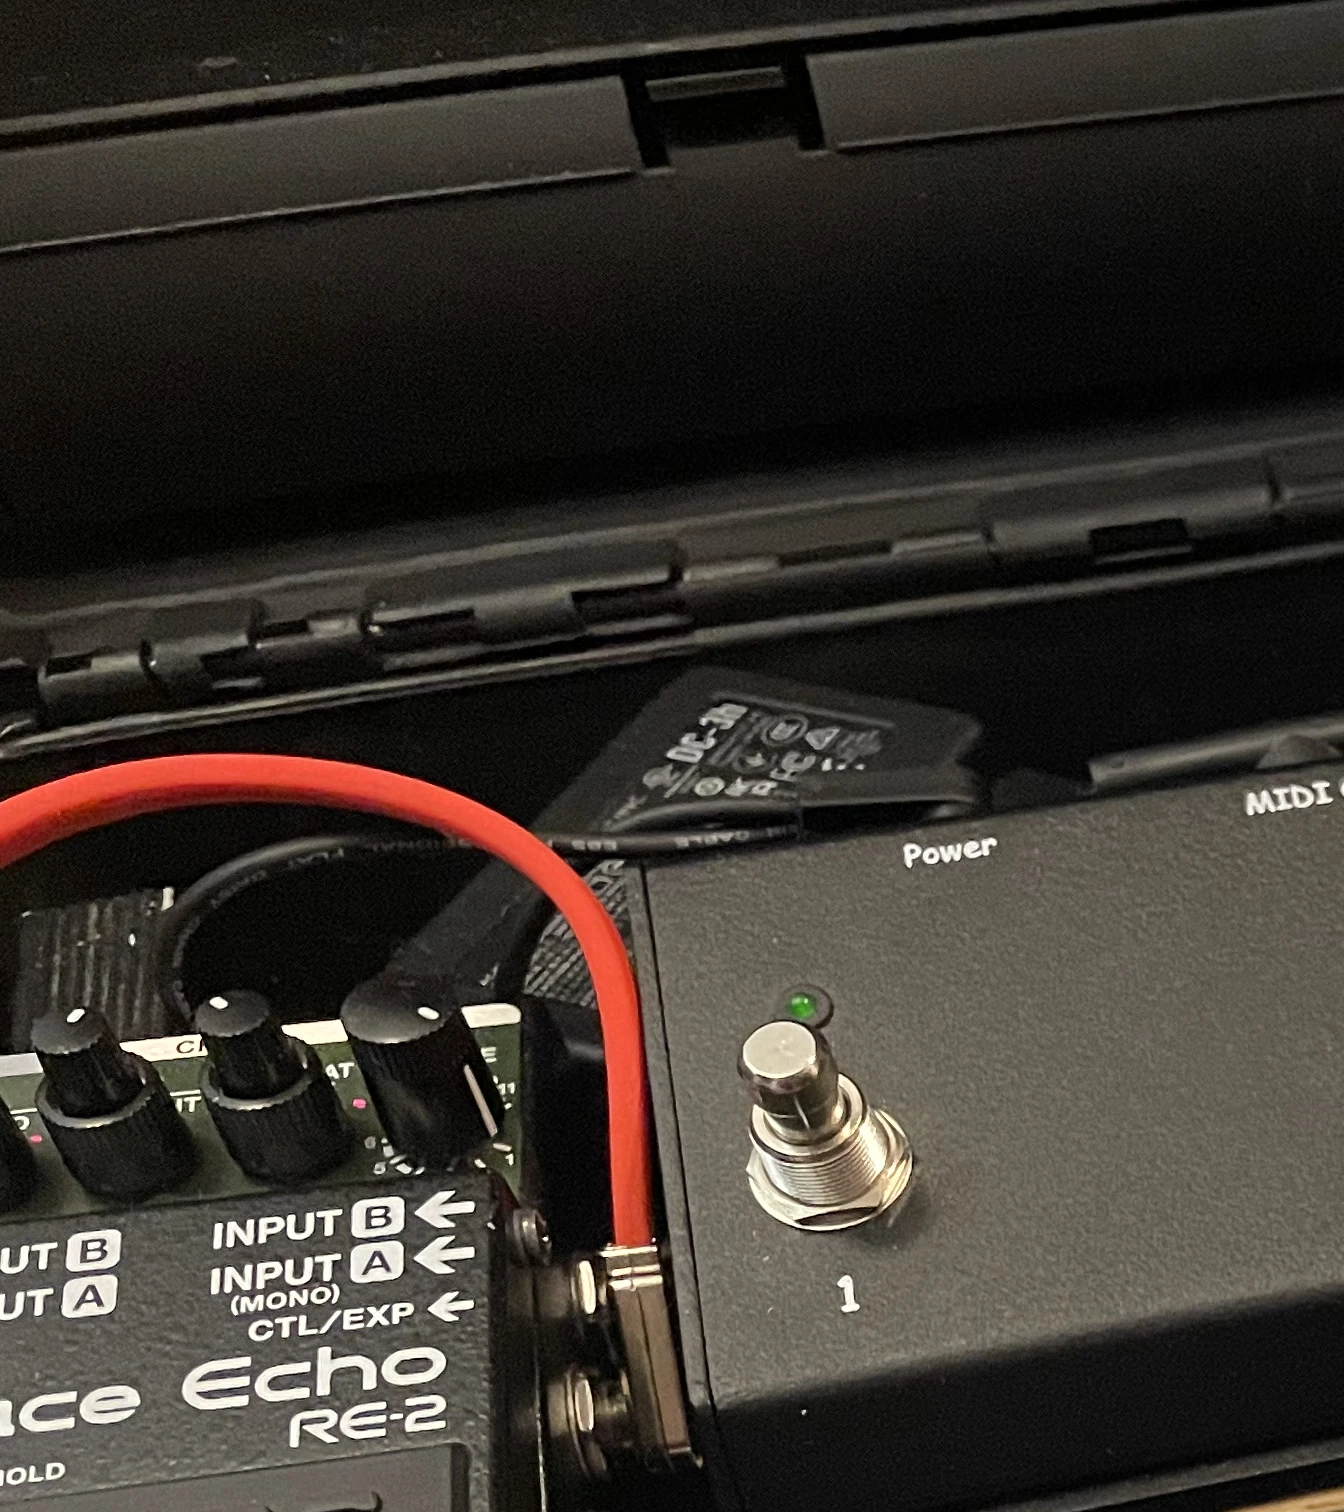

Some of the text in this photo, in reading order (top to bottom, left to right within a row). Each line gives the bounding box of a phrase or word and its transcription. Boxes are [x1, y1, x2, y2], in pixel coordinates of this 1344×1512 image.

[1244, 778, 1333, 816] MIDI
[902, 834, 998, 869] Power
[211, 1208, 344, 1250] INPUT
[209, 1252, 343, 1296] INPUT
[836, 1274, 861, 1313] 1
[230, 1283, 342, 1317] (MONO)
[247, 1301, 416, 1342] CTL/EXP
[180, 1345, 448, 1411] Echo
[288, 1393, 448, 1449] RE-2
